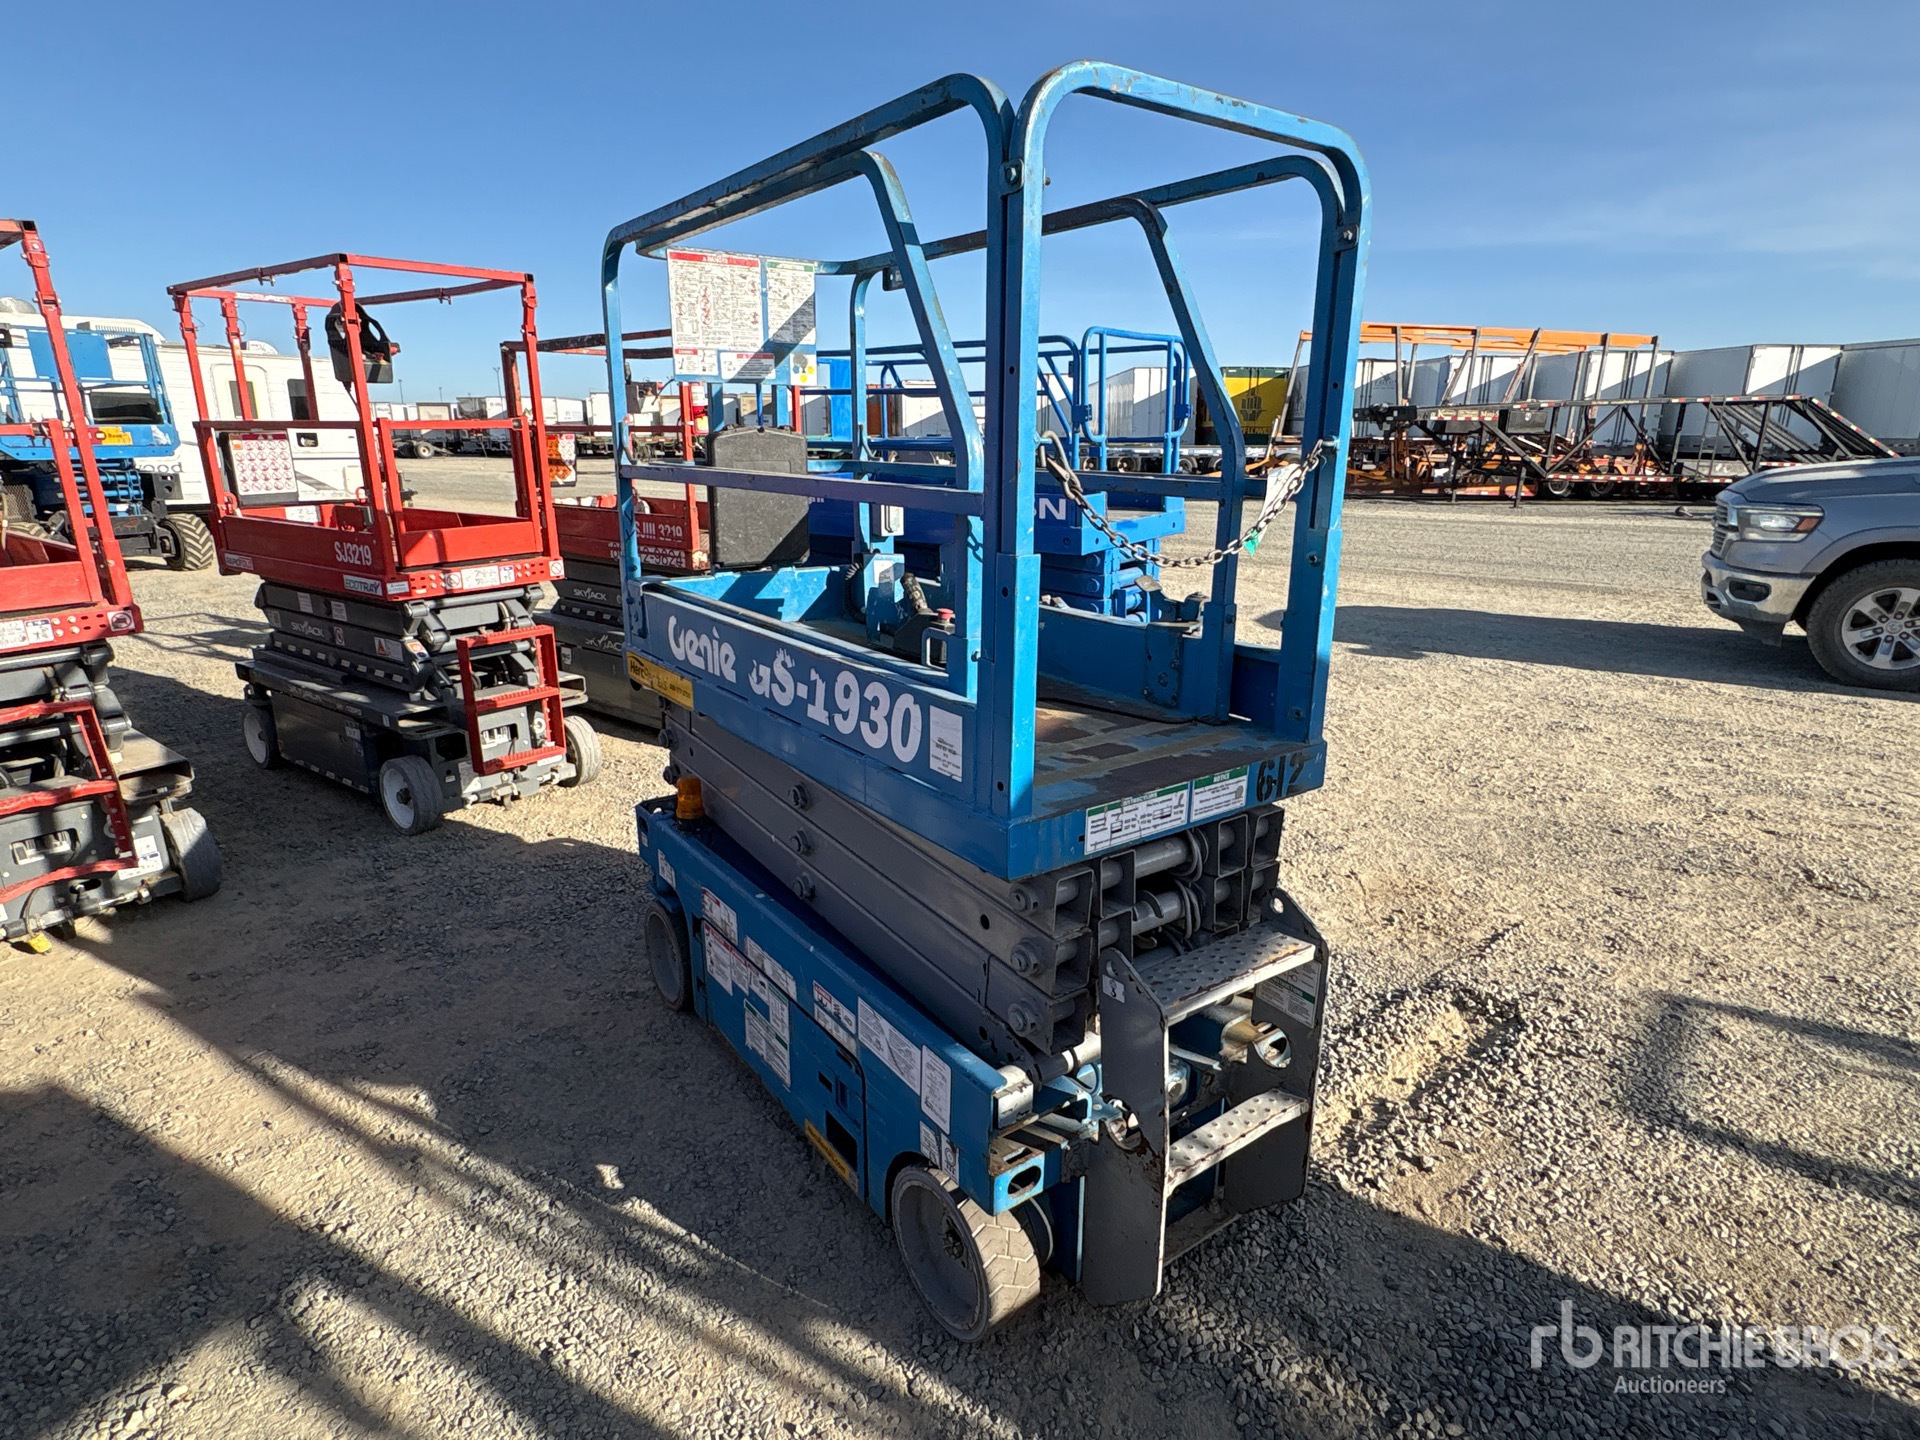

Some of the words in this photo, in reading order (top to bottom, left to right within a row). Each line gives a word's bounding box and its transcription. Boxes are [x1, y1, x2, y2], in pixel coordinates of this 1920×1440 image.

[334, 541, 372, 566] SJ3219
[345, 578, 380, 594] ECOTRAY
[574, 587, 607, 600] SKYJACK
[291, 620, 325, 638] SKYJACK
[585, 635, 622, 652] SKYJAC
[668, 615, 736, 683] Genie
[1213, 772, 1230, 783] NOTICE
